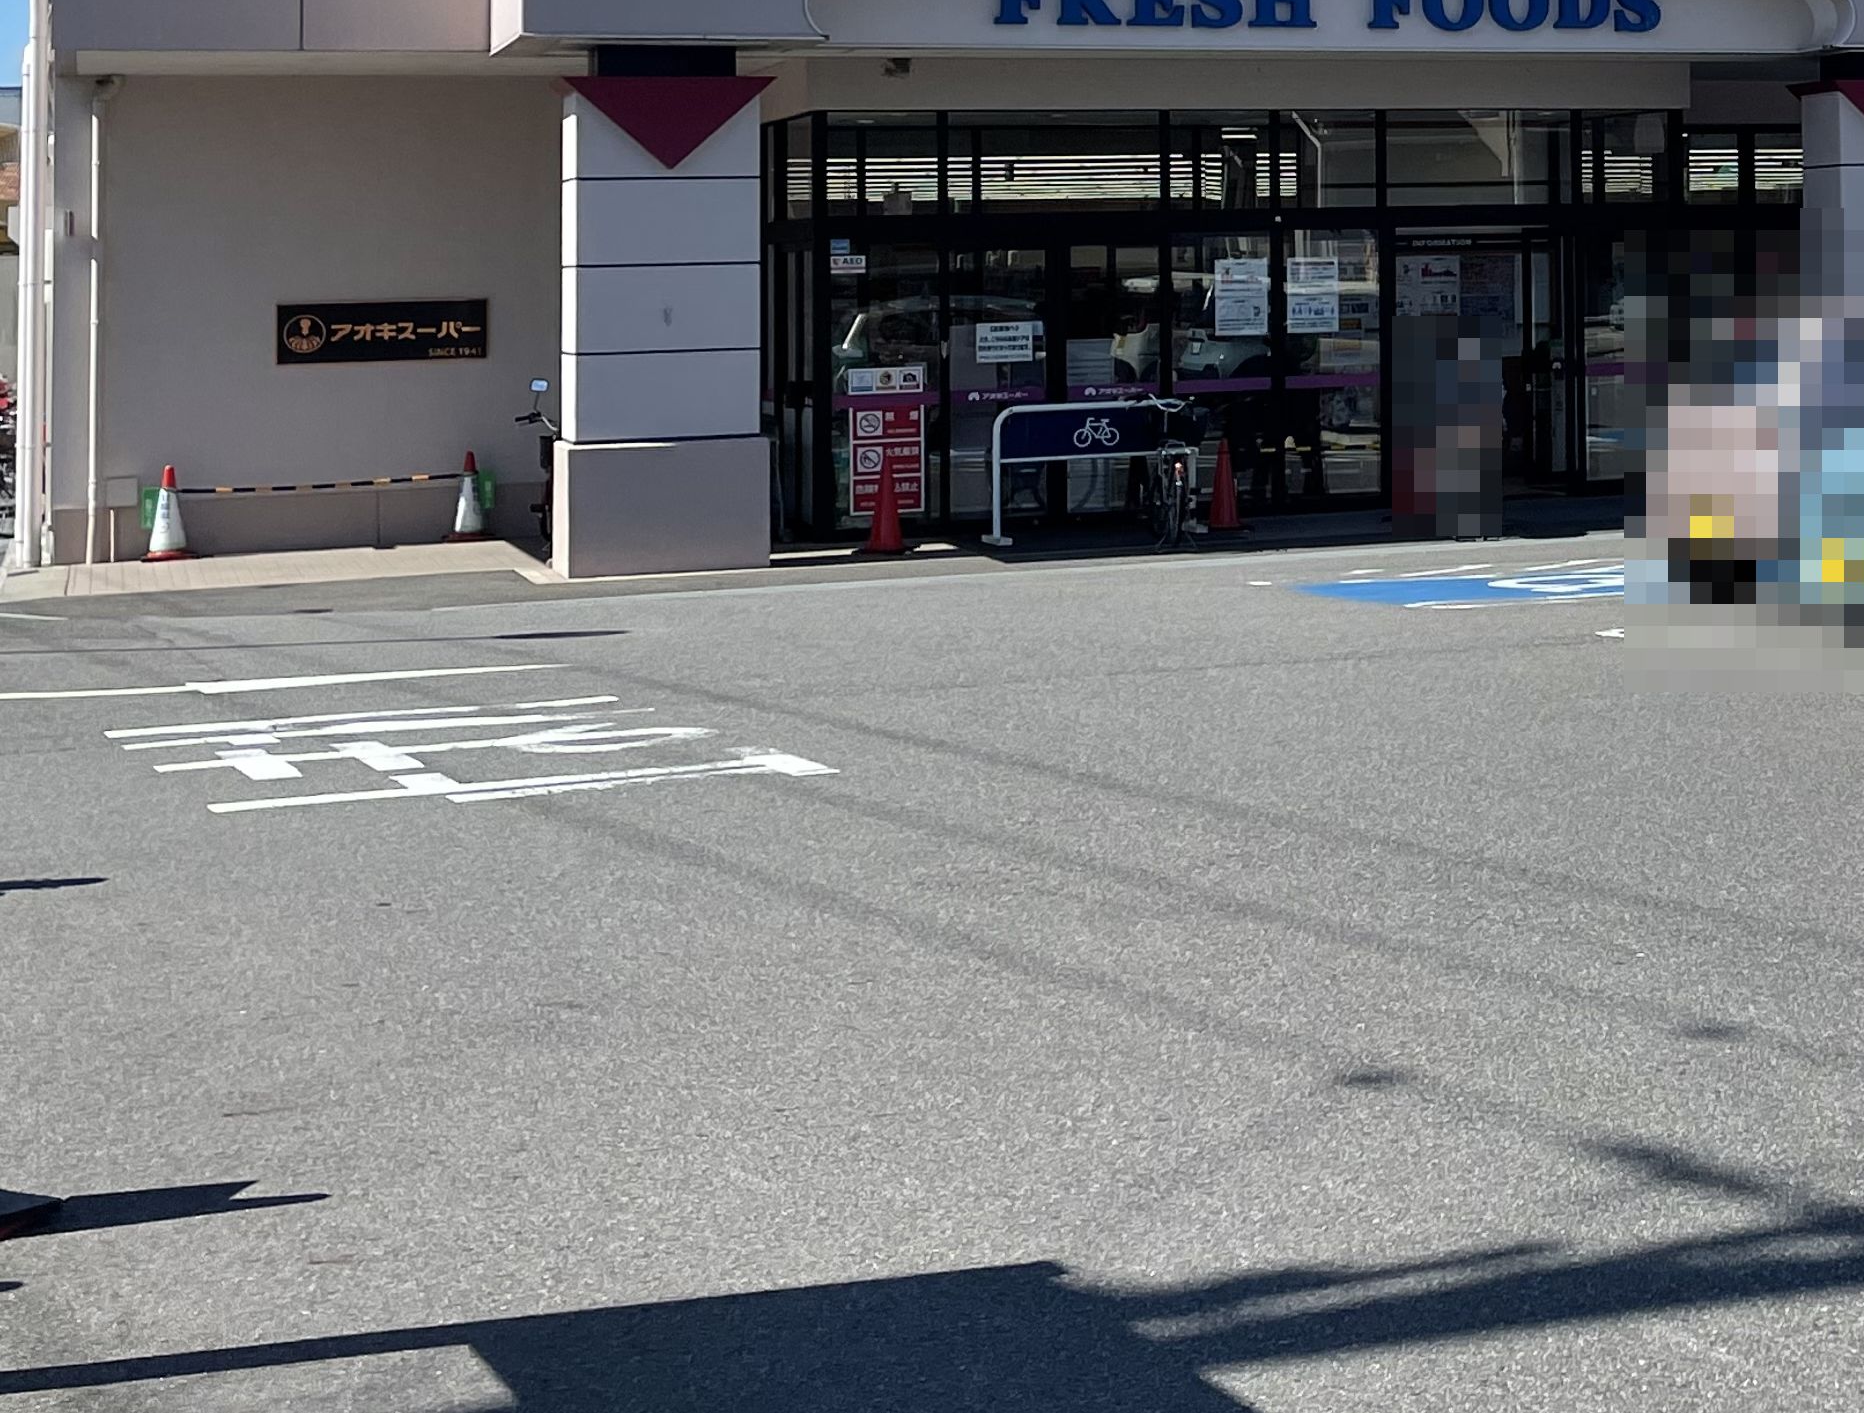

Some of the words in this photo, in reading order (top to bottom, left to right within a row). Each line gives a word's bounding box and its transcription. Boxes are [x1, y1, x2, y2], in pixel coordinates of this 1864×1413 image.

[330, 320, 482, 341] アオキスーパー
[428, 346, 456, 357] SINCE
[458, 345, 482, 357] 1941
